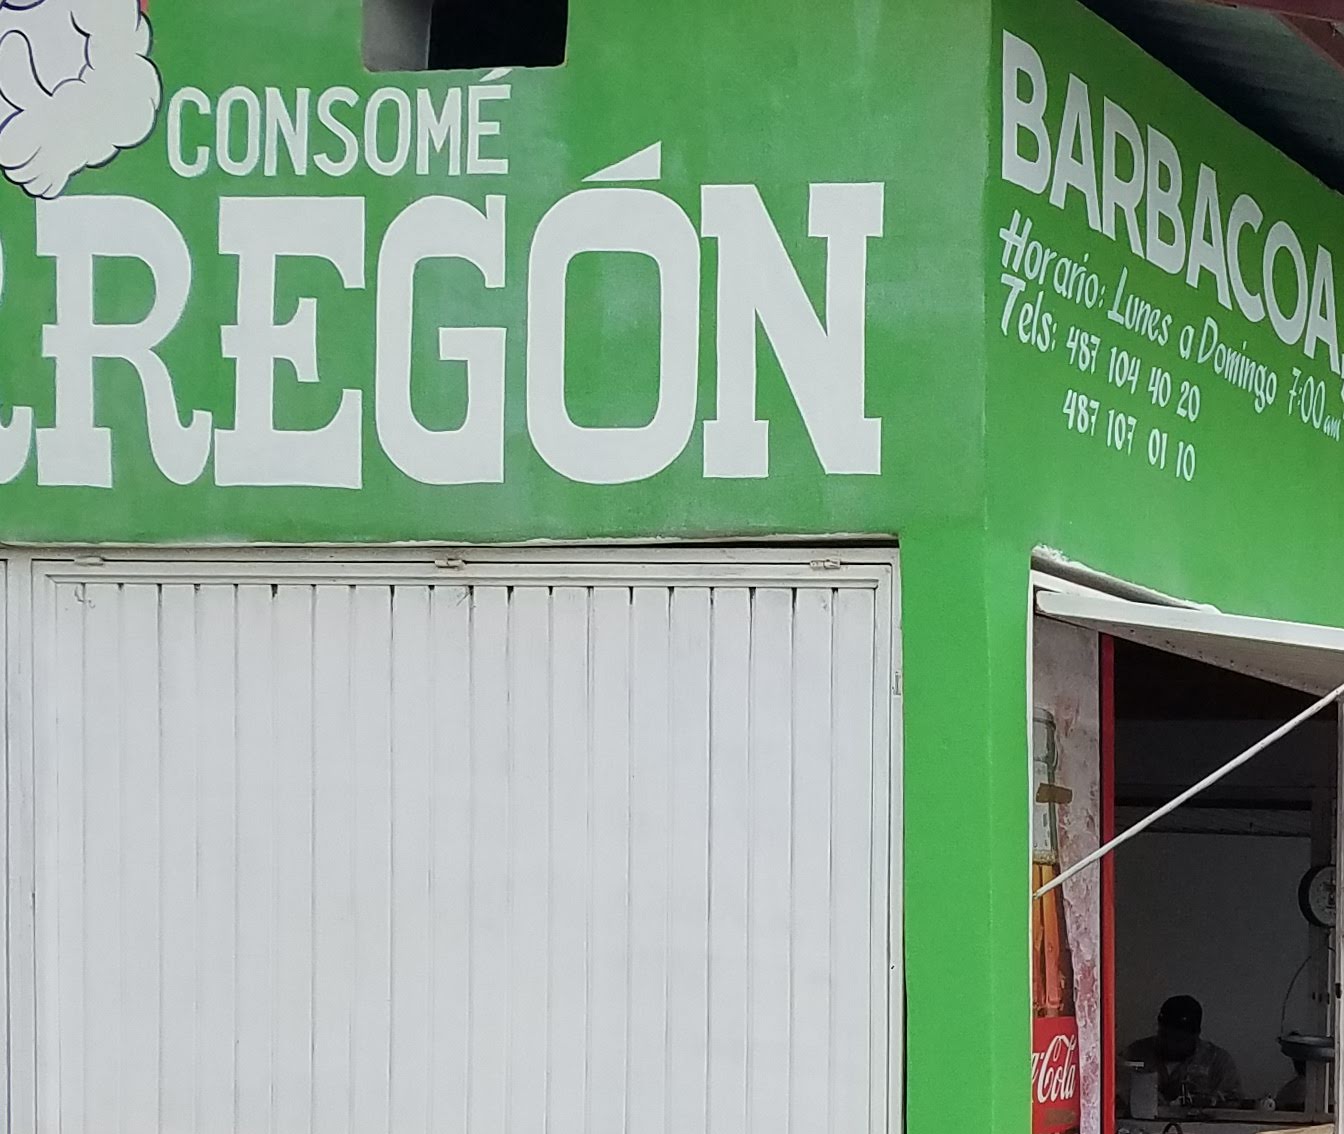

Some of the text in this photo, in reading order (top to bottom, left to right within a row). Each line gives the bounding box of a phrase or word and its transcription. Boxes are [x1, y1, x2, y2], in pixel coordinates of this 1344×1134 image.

[167, 69, 512, 178] CONSOMÉ
[0, 141, 885, 490] REGÓN
[999, 209, 1107, 309] Horario:
[1107, 266, 1173, 347] Lunes
[1179, 325, 1195, 361] a
[1197, 316, 1278, 415] Domingo
[1001, 273, 1201, 423] Tels: 487 104 40 20
[1062, 389, 1196, 483] 487 107 01 10
